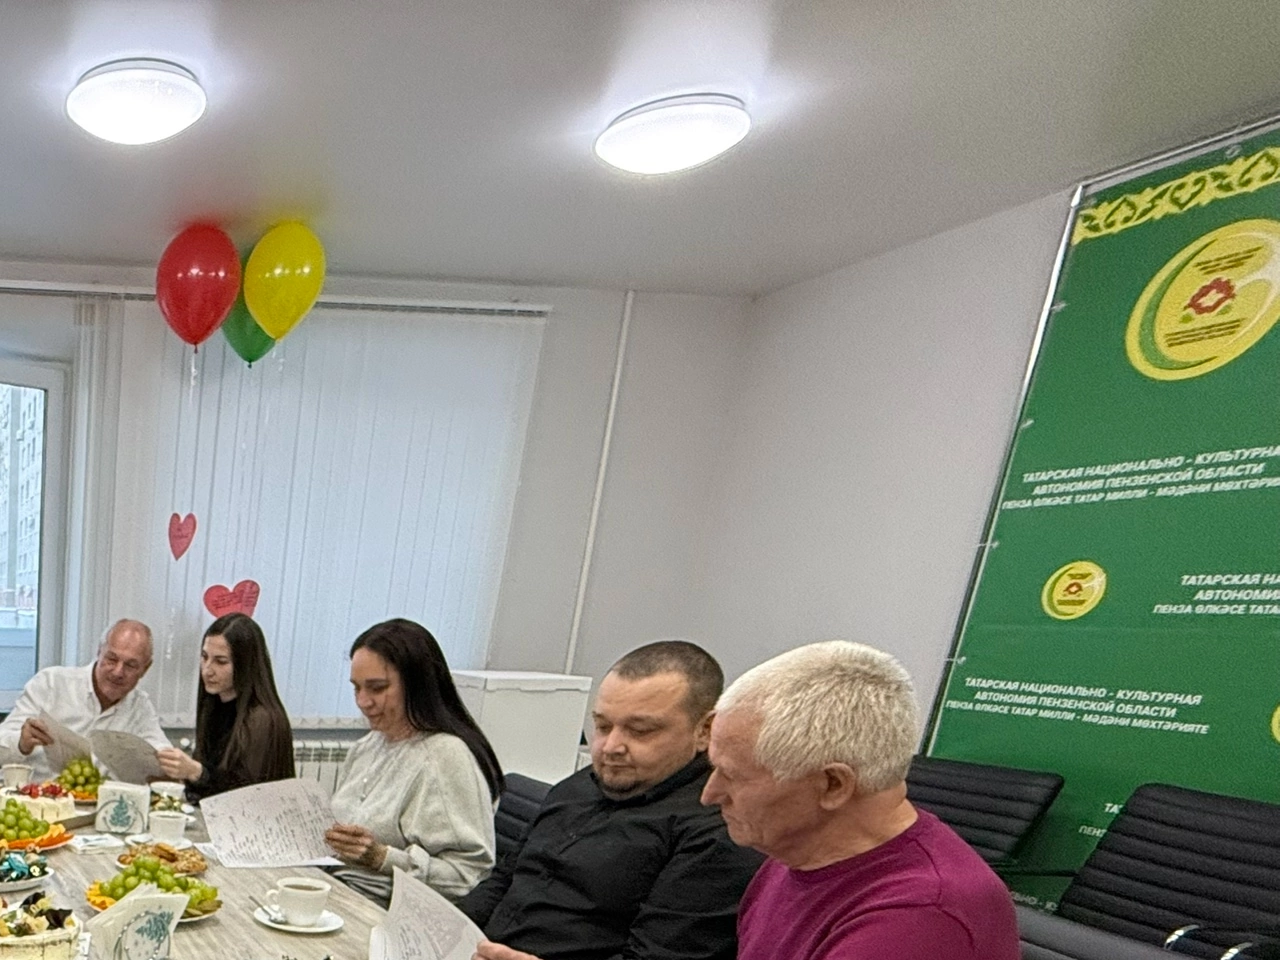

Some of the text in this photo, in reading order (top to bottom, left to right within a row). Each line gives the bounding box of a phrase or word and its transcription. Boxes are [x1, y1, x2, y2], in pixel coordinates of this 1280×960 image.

[1023, 467, 1085, 483] ТАТАРСКАЯ
[1084, 456, 1185, 477] НАЦИОНАЛЬНО
[1194, 445, 1280, 465] КУЛЬТУРНА
[1032, 462, 1266, 495] АВТОНОМИЯ ПЕНЗЕНСКОЙ ОБЛАСТИ
[1181, 574, 1261, 585] ТАТАРСКАЯ
[1193, 589, 1280, 600] АВТОНОМИ
[1152, 604, 1193, 614] ПЕНЗА
[1248, 604, 1280, 615] ТАТА
[965, 677, 1020, 691] ТАТАРСКАЯ
[1019, 682, 1107, 698] НАЦИОНАЛЬНО
[1115, 689, 1203, 706] КУЛЬТУРНАЯ
[974, 691, 1178, 719] АВТОНОМИЯ ПЕНЗЕНСКОЙ ОБЛАСТИ
[1010, 706, 1038, 717] ТАТАР
[1037, 709, 1076, 721] МИЛЛИ
[1079, 825, 1107, 837] ПЕНЗ
